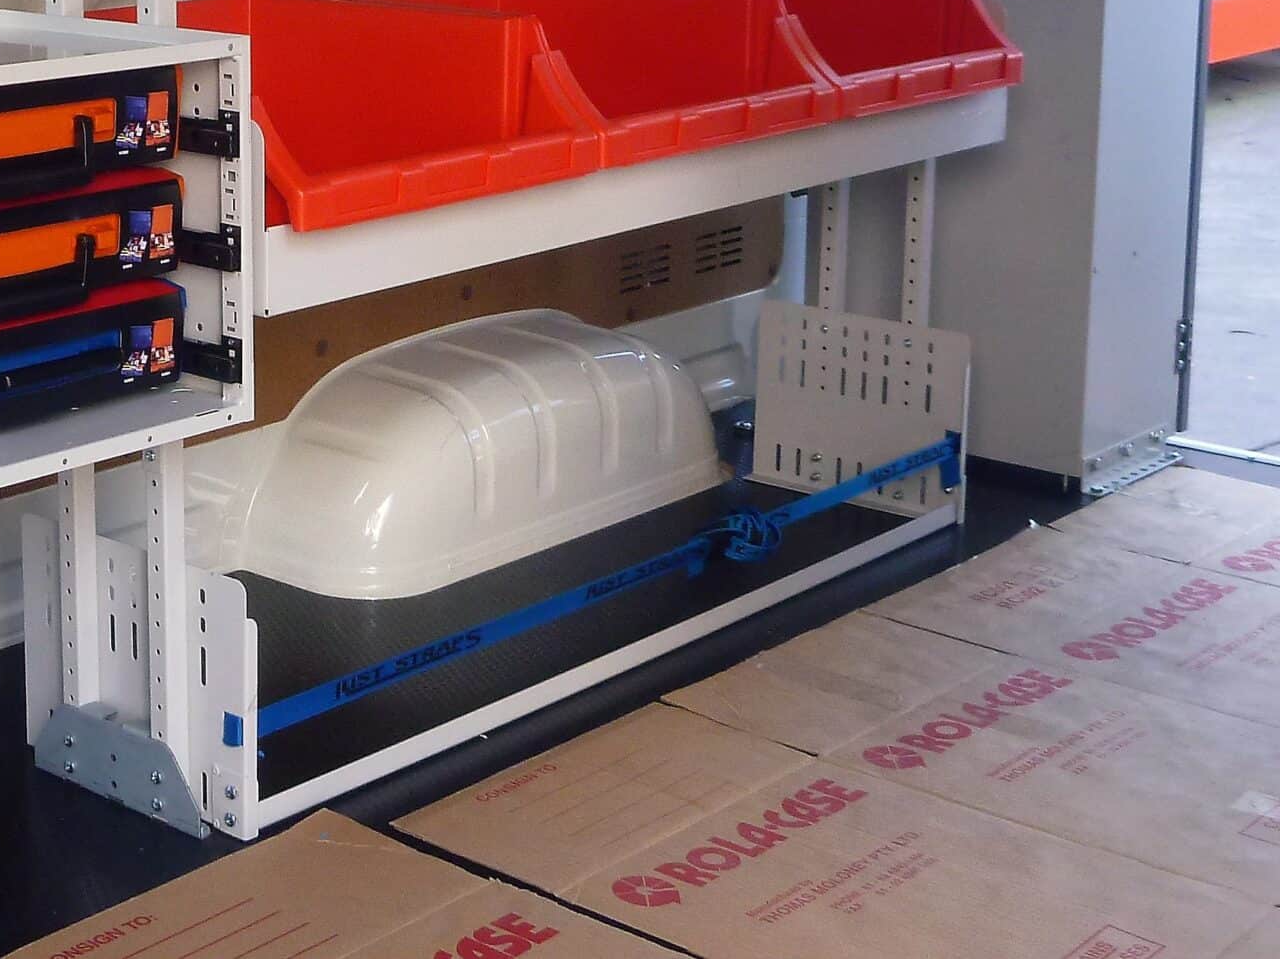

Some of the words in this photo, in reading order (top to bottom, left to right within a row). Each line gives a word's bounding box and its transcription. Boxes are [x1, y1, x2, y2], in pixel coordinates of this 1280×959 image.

[759, 891, 817, 924] THOMAS
[814, 858, 871, 896] MOLONEY
[50, 927, 124, 959] ONSIGN
